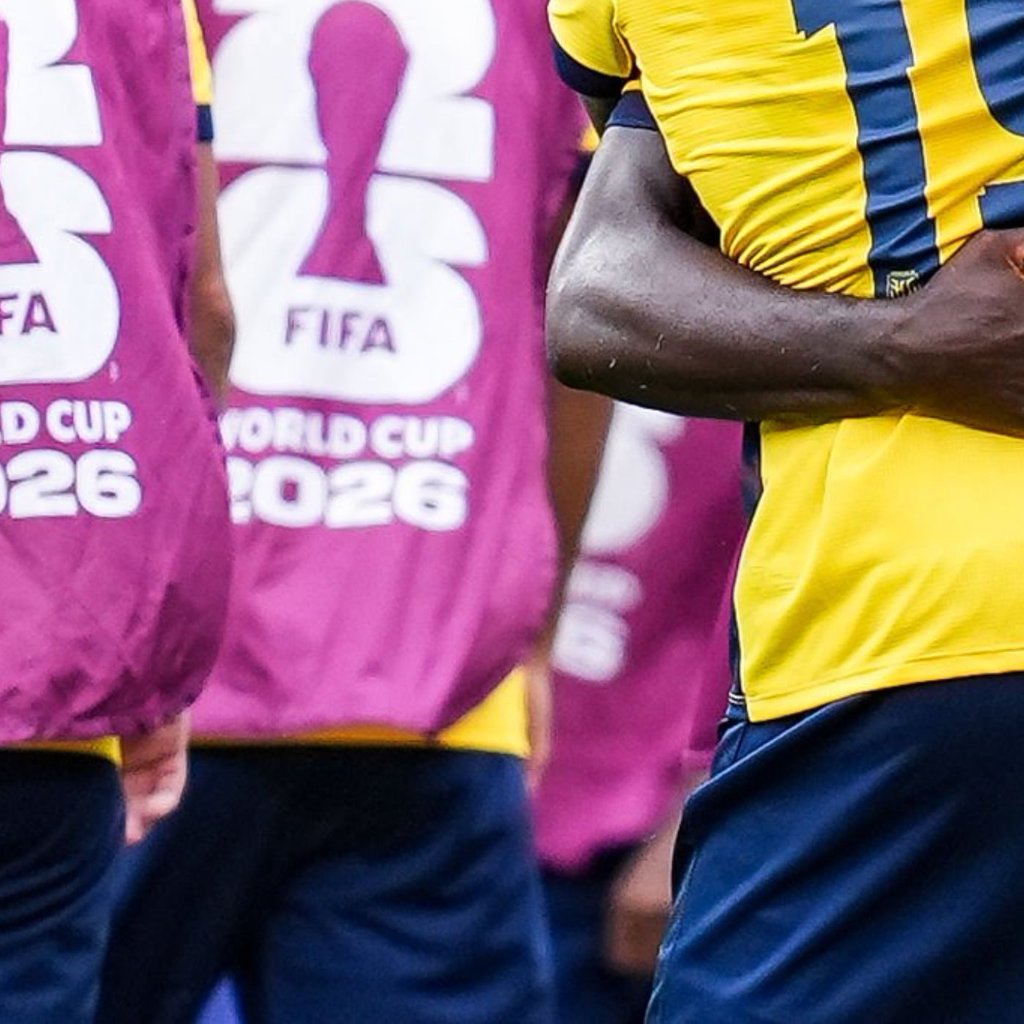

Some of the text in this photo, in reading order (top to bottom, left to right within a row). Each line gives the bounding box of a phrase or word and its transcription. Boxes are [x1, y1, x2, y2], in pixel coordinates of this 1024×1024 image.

[284, 305, 396, 353] FIFA
[45, 398, 132, 444] CUP
[370, 413, 475, 461] CUP
[0, 448, 143, 518] 26
